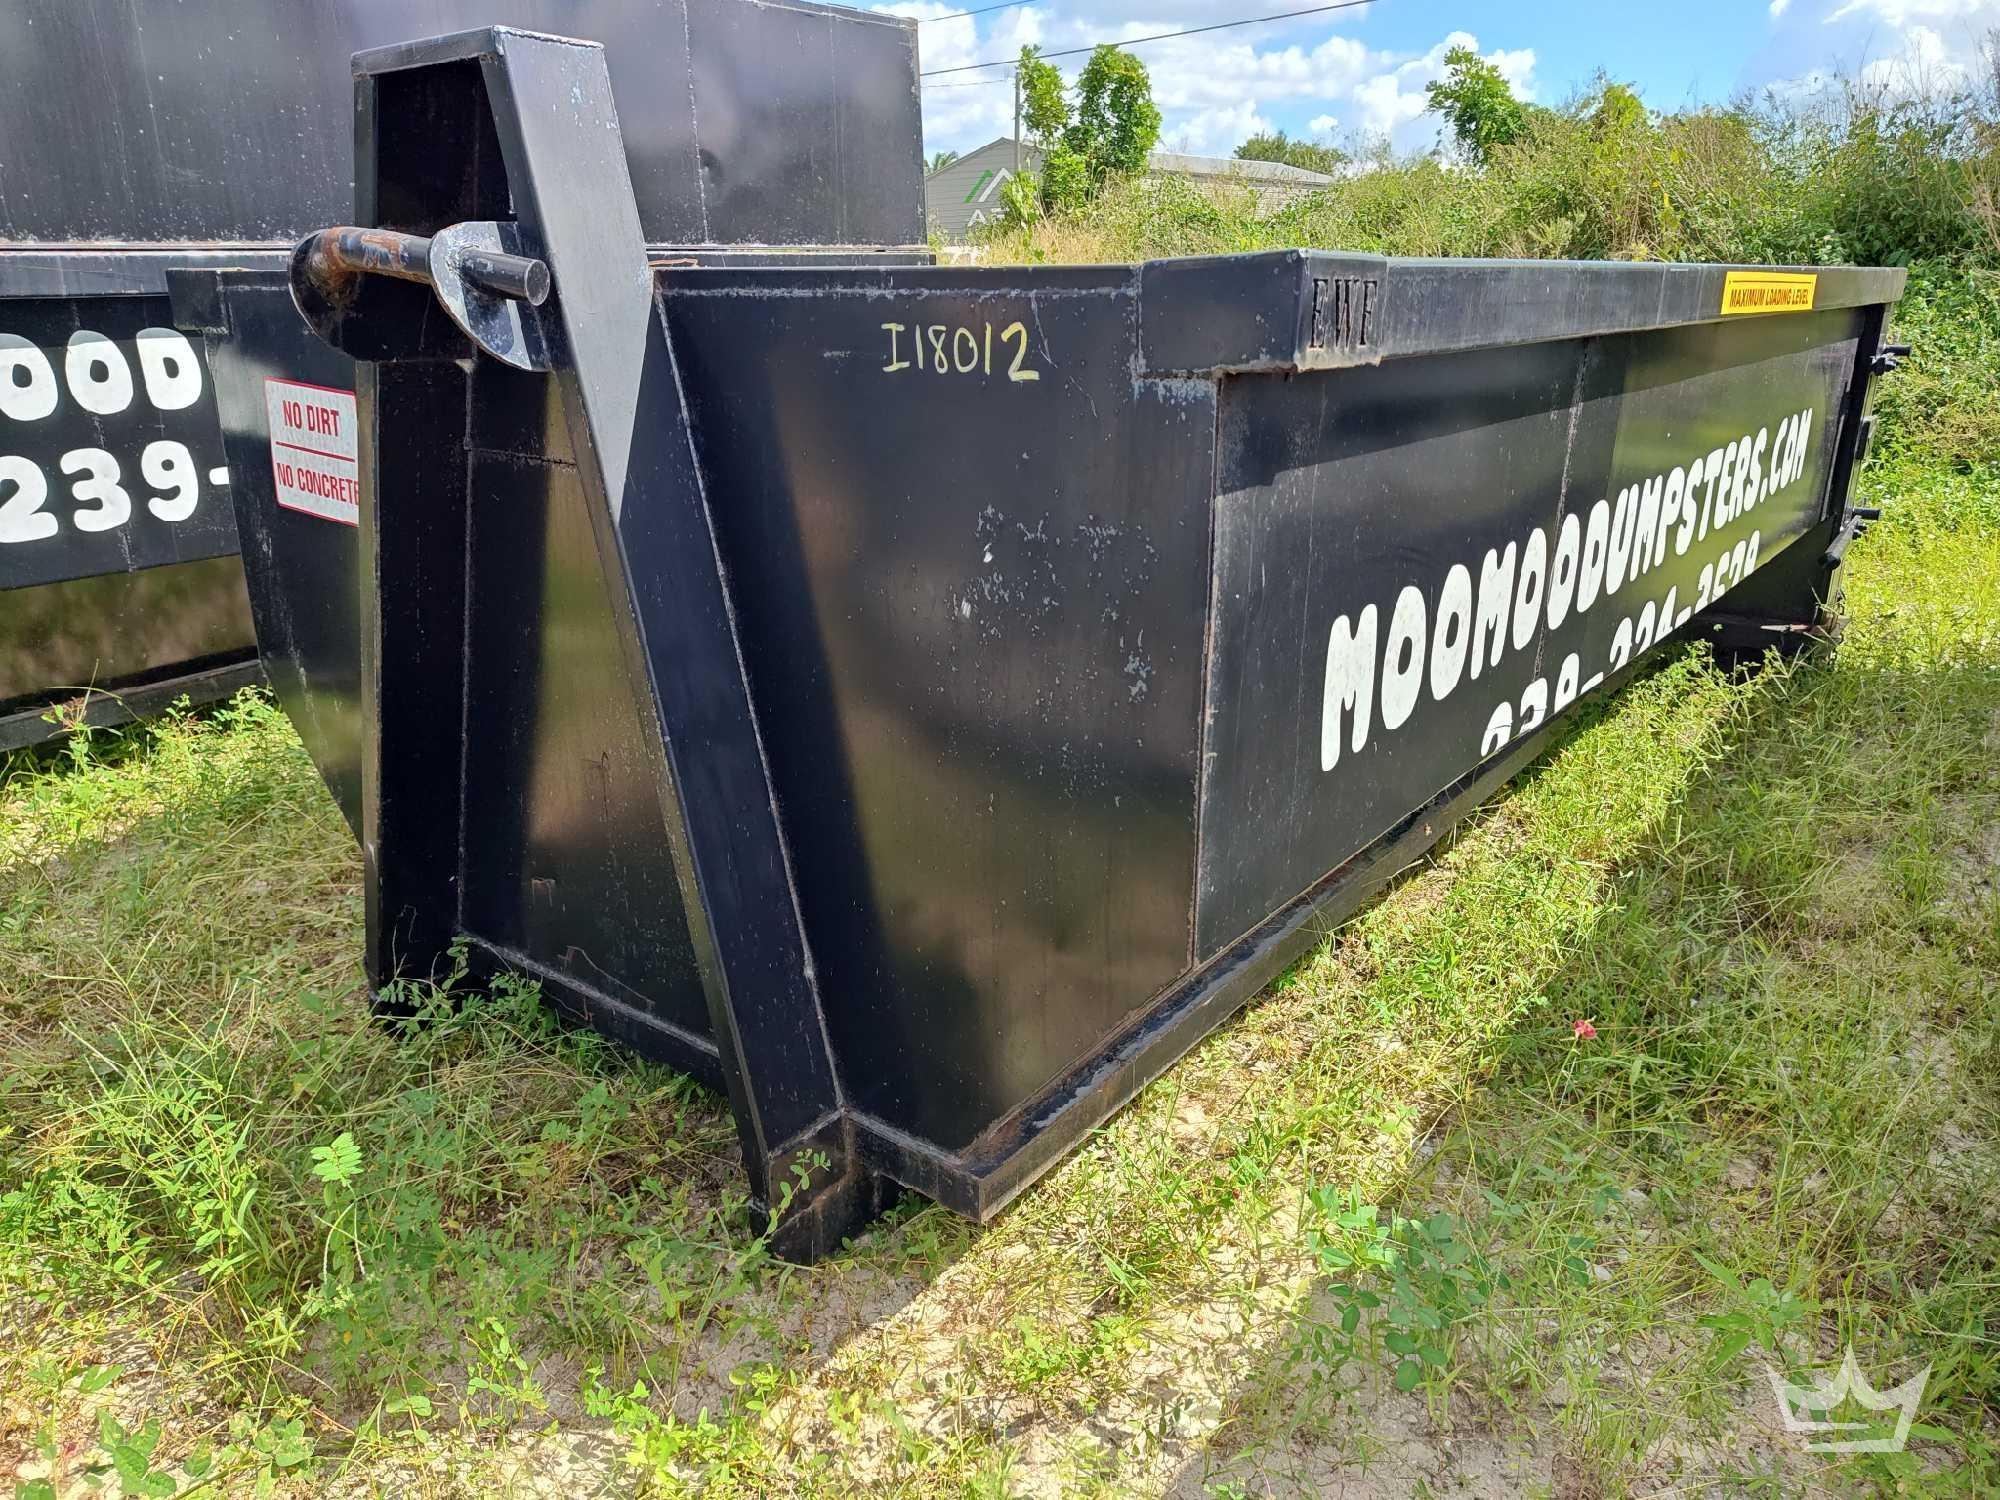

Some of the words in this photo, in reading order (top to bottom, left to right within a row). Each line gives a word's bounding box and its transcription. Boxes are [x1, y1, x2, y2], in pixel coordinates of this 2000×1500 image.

[1729, 288, 1764, 308] MAXIMUM
[1765, 288, 1793, 306] LOADING
[1791, 288, 1809, 305] LEVEL
[282, 399, 302, 430] NO
[306, 405, 340, 437] DIRT
[276, 462, 294, 489] NO
[1320, 407, 1813, 772] MOOMOODUMPSTERS.COM
